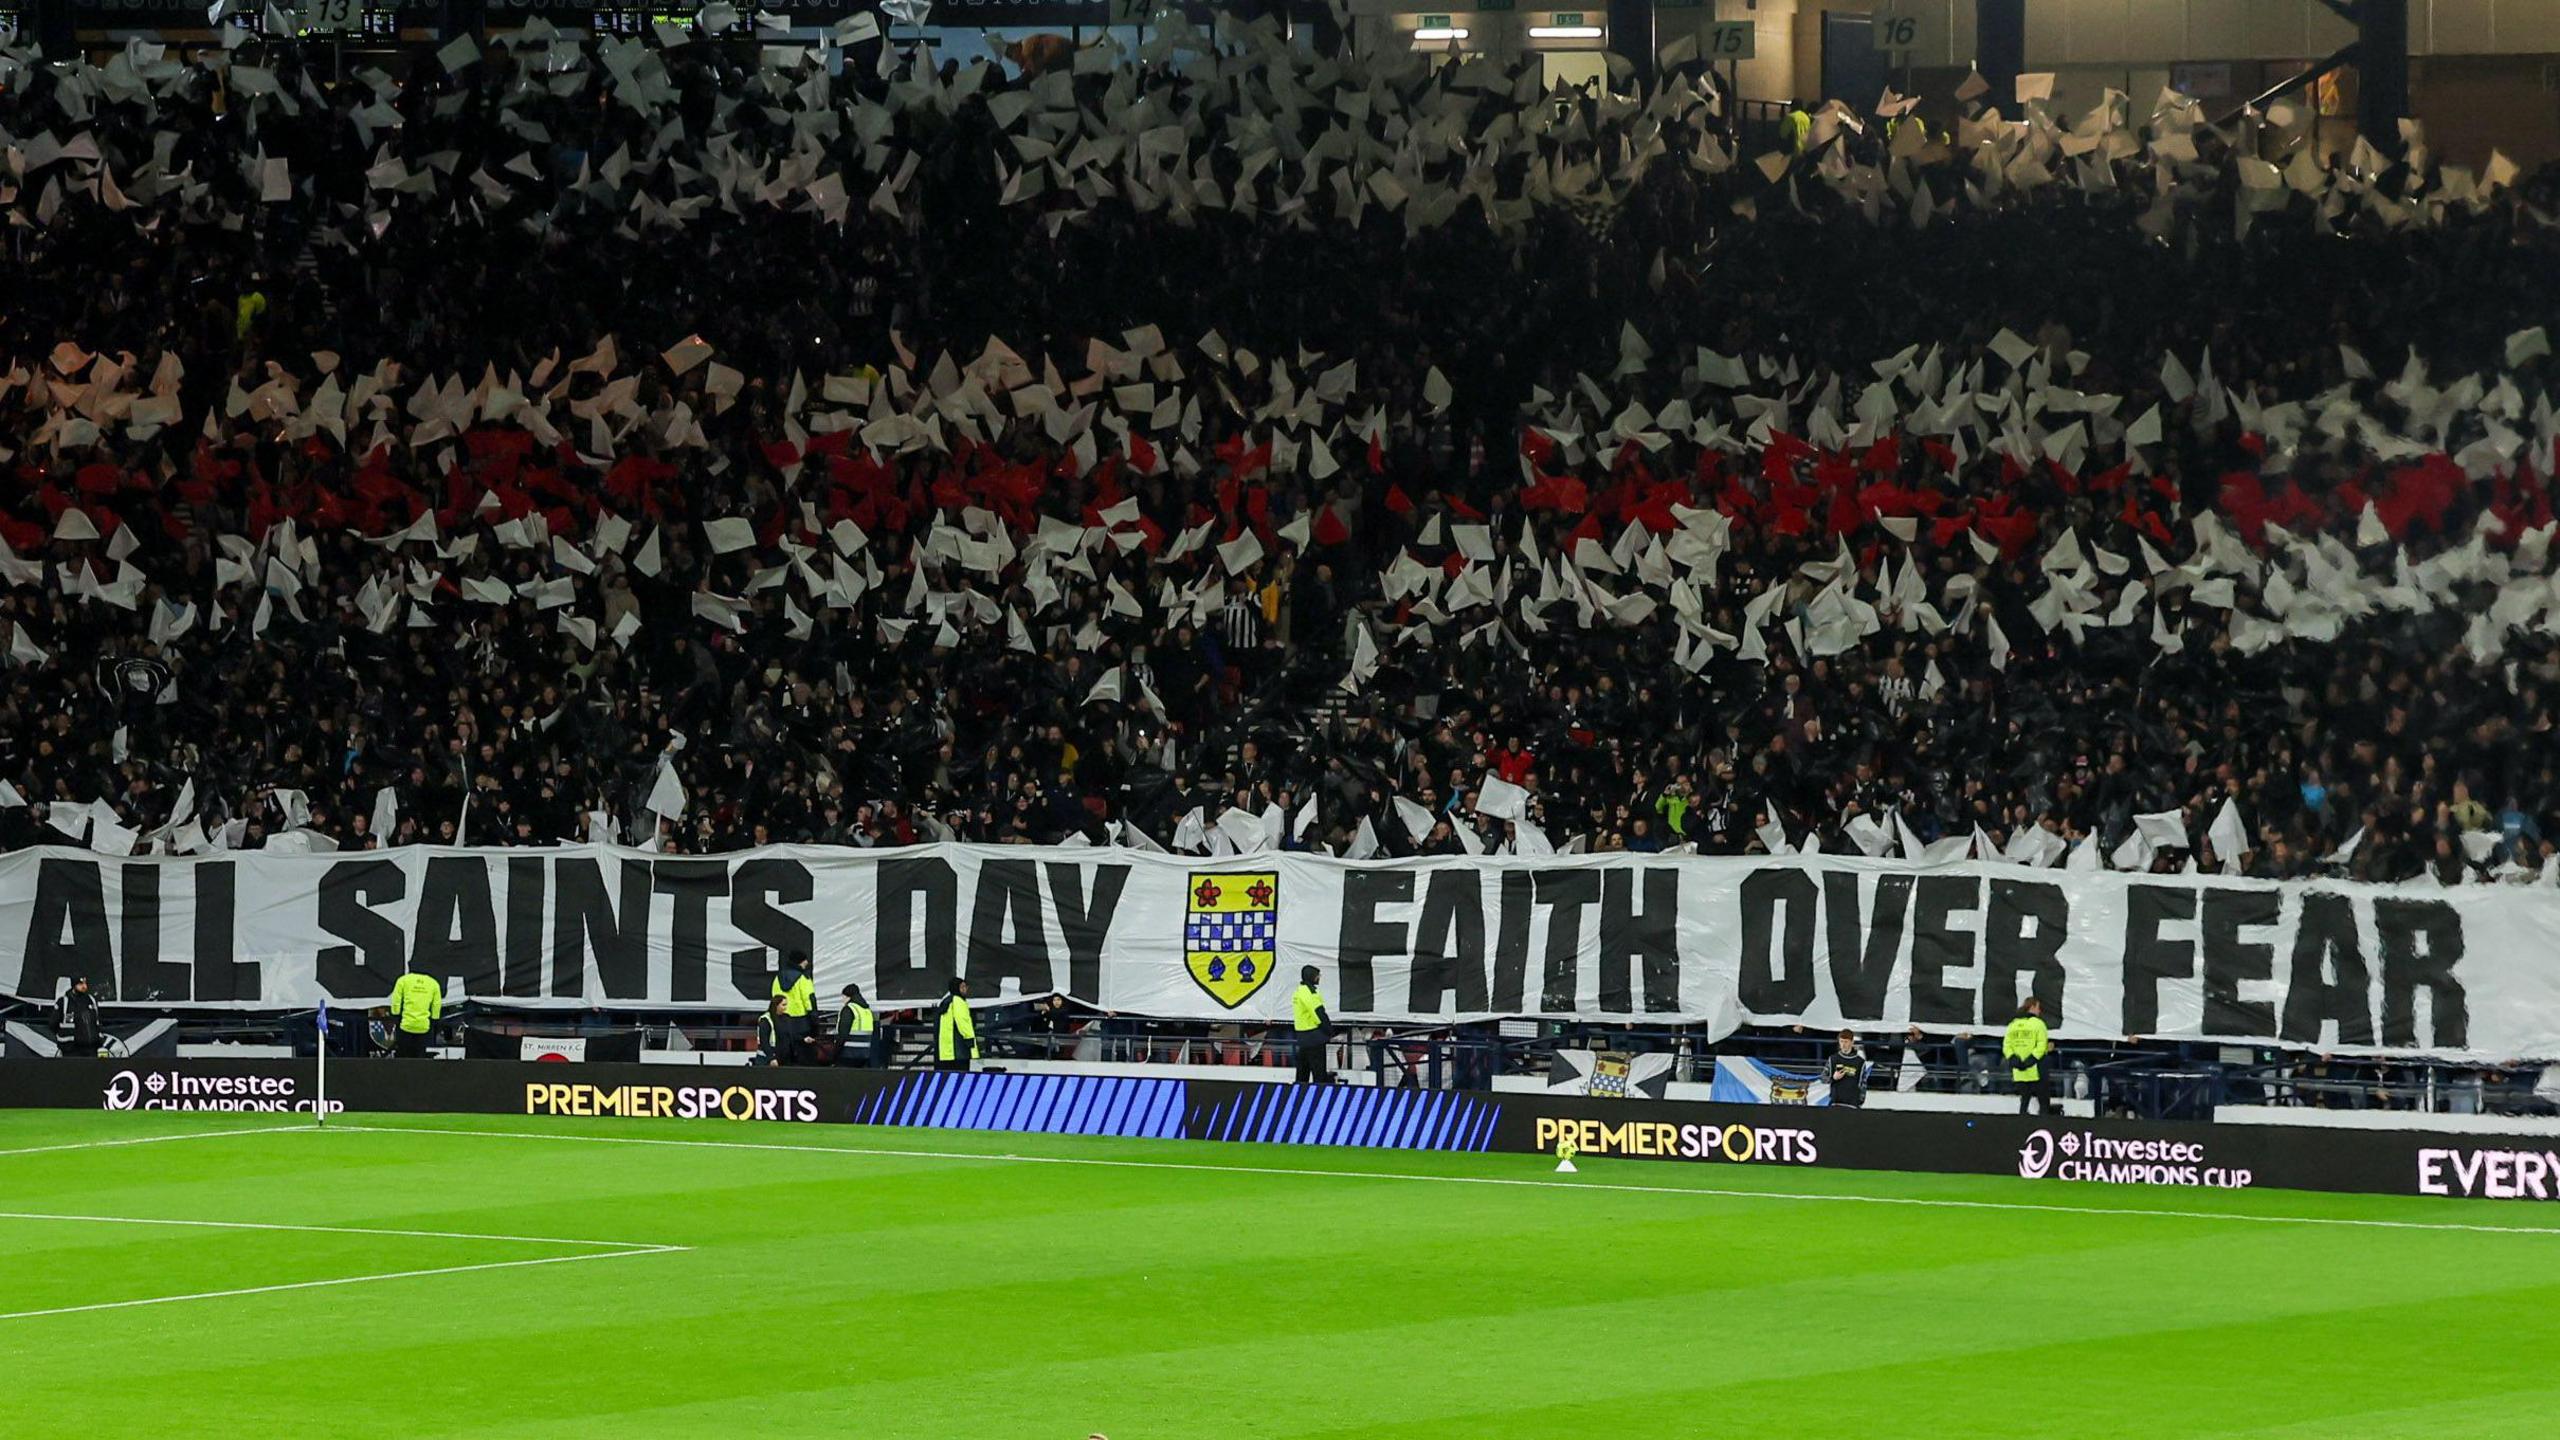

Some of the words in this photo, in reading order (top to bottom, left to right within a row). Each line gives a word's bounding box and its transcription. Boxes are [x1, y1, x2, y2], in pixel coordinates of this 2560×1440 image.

[319, 0, 350, 22] 13
[1712, 28, 1743, 54] 15
[1884, 17, 1915, 45] 16
[16, 857, 262, 1003] ALL
[316, 856, 814, 1002] SAINTS
[875, 857, 1132, 1005] DAY
[1338, 867, 1681, 1014] FAITH
[1738, 867, 2069, 1031] OVER
[2121, 883, 2470, 1050] FEAR
[171, 1071, 295, 1096] Investec
[145, 1099, 288, 1112] CHAMPIONS
[2084, 1131, 2204, 1162] Investec
[2058, 1160, 2199, 1186] CHAMPIONS
[2203, 1167, 2252, 1188] CUP
